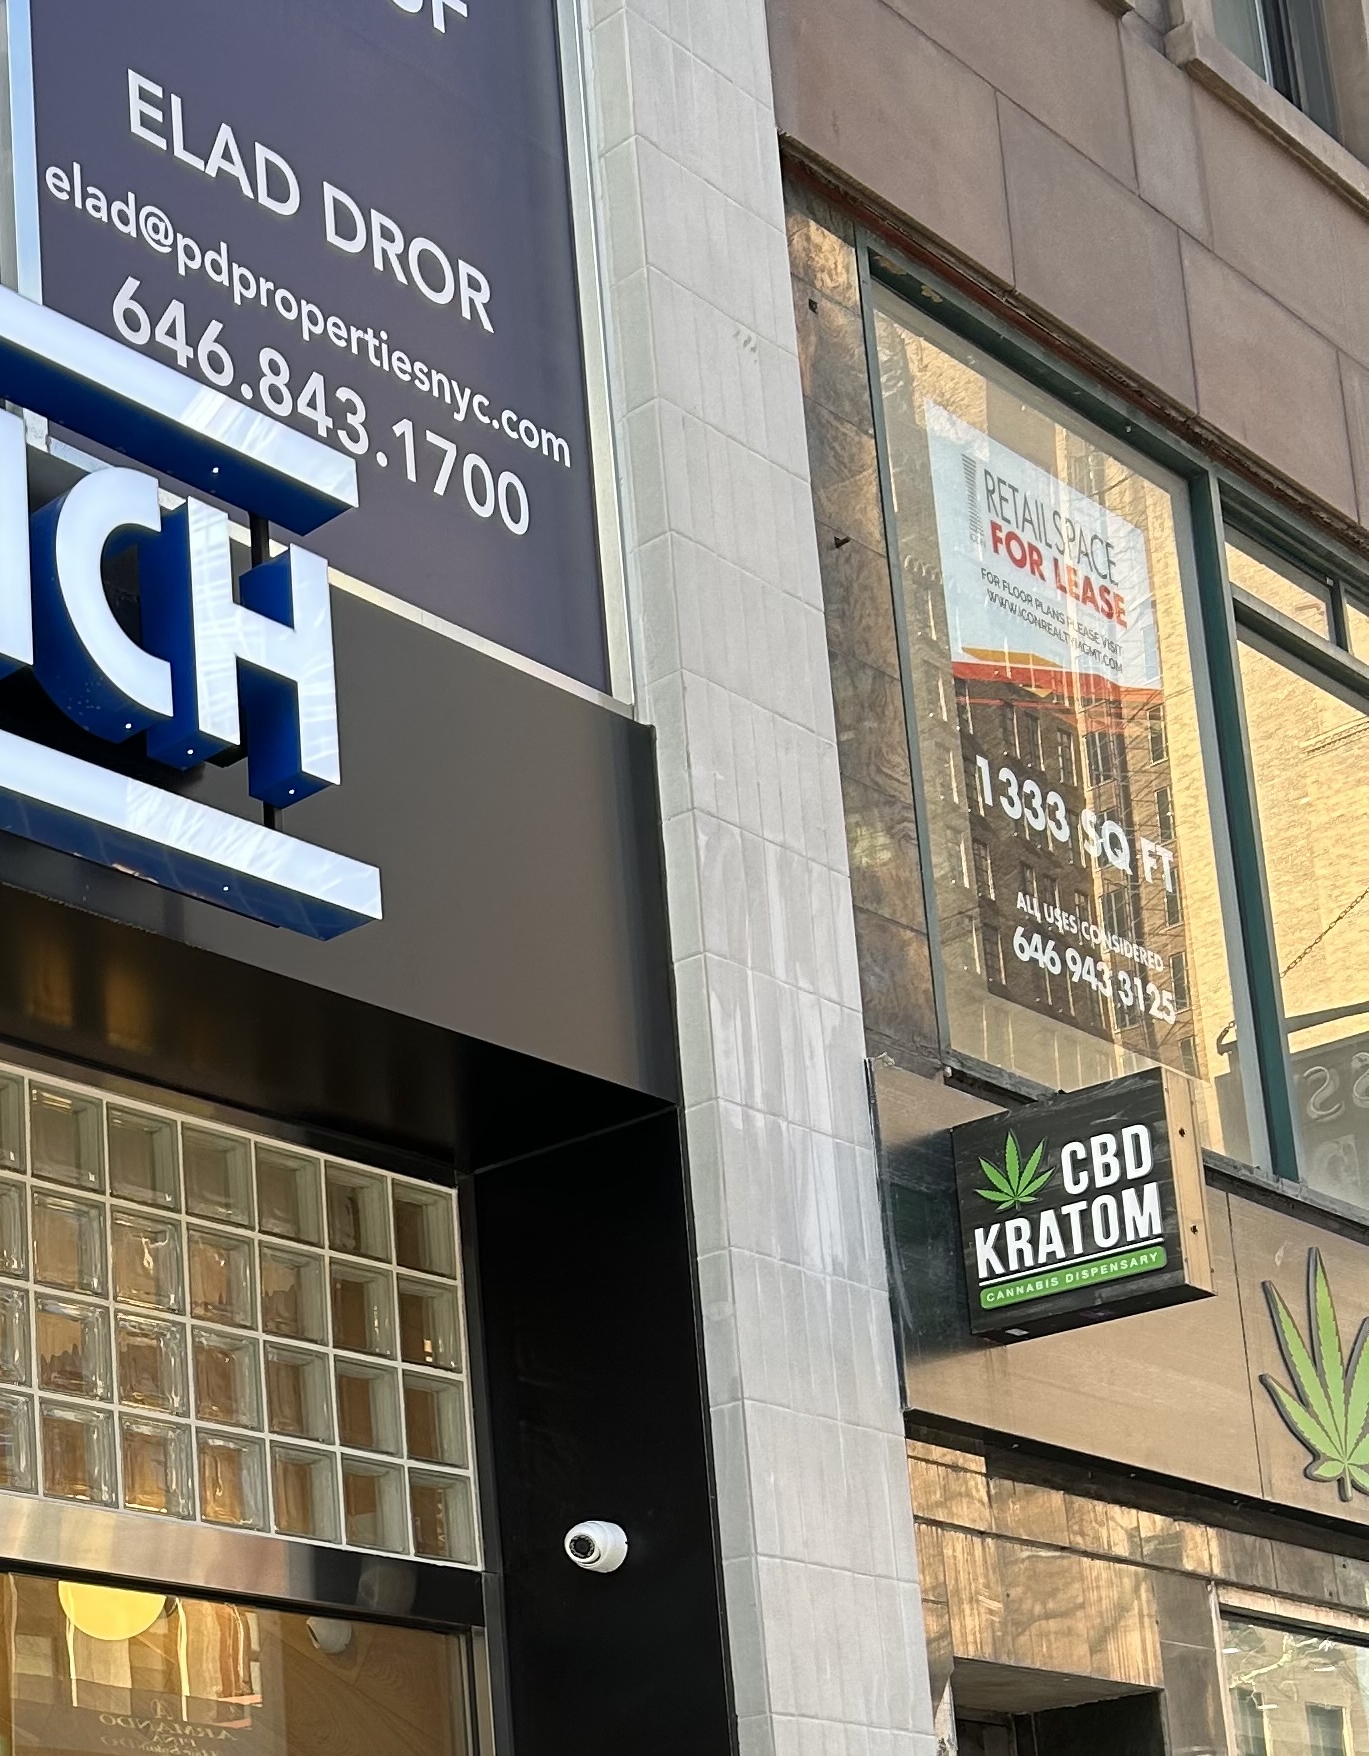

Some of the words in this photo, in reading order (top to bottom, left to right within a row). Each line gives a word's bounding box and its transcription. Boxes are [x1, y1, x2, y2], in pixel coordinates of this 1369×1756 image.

[128, 69, 300, 216] ELAD
[323, 181, 494, 333] DROR
[45, 162, 572, 468] elad@pdpropertiesnyc.com
[112, 277, 530, 536] 646.843.1700
[984, 468, 1052, 550] RETAIL
[1052, 509, 1119, 587] SPACE
[991, 519, 1046, 582] FOR
[1053, 556, 1128, 629] LEASE
[981, 567, 1001, 589] FOR
[1002, 579, 1034, 609] FLOOR
[1034, 597, 1065, 626] PLANS
[975, 755, 1070, 843] 1333
[1080, 808, 1133, 875] SQ
[1140, 837, 1175, 893] FT
[1013, 926, 1061, 975] 646
[1066, 947, 1112, 998] 943
[1118, 971, 1177, 1025] 3125
[1016, 891, 1041, 924] ALL
[1044, 902, 1079, 935] USES
[1081, 920, 1164, 973] CONSIDERED
[1061, 1124, 1153, 1196] CBD
[974, 1182, 1162, 1279] KRATOM
[986, 1276, 1060, 1303] CANNABIS
[1065, 1251, 1159, 1284] DISPENSARY
